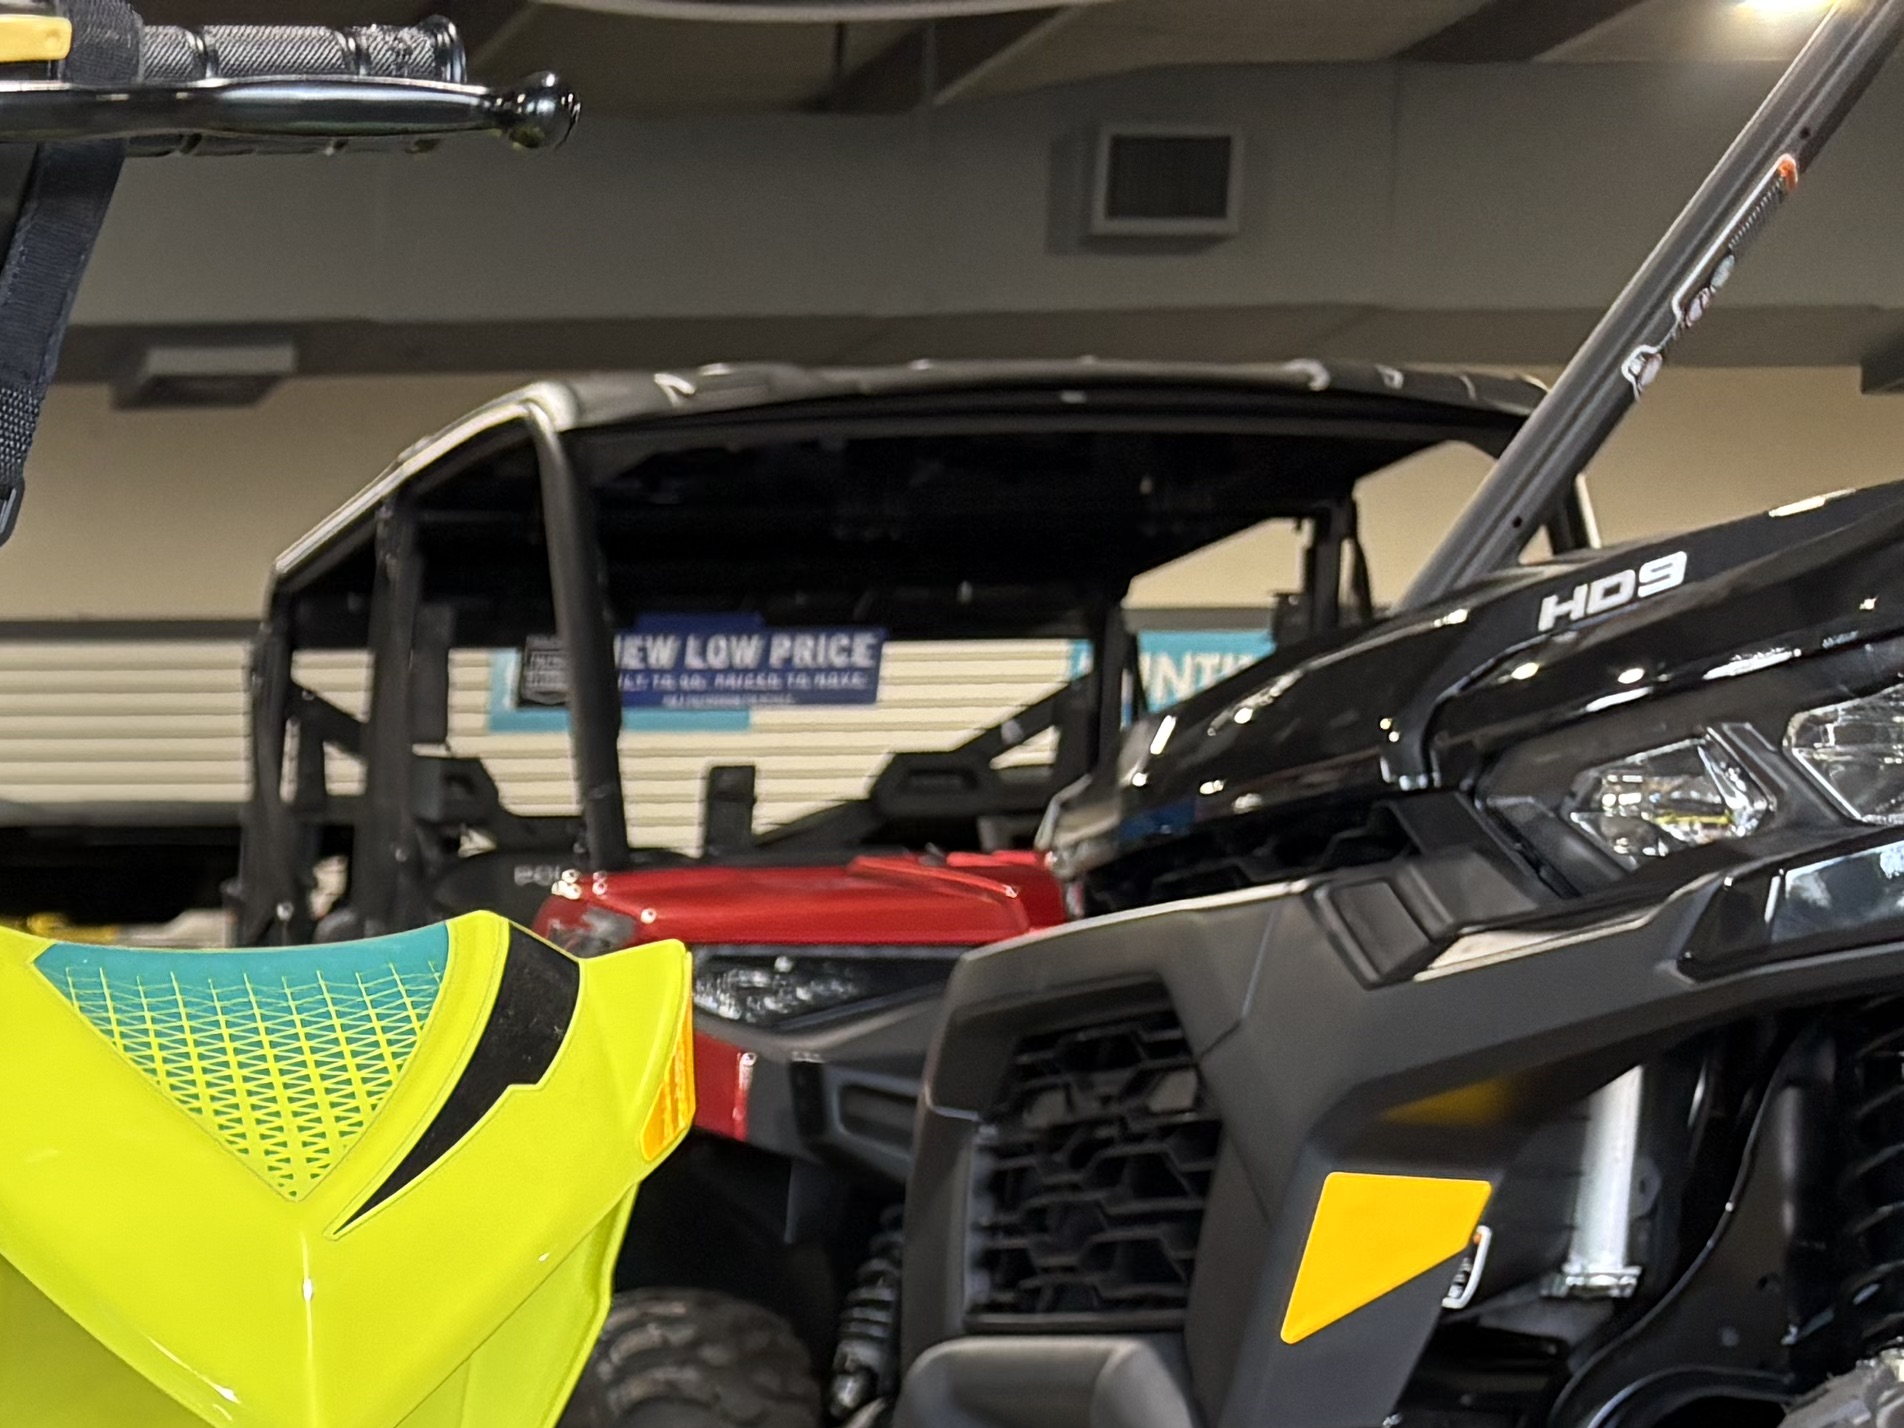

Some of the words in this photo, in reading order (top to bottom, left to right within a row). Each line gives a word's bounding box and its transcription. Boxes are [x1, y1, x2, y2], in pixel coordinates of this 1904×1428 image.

[1538, 551, 1688, 632] HD9
[612, 632, 681, 671] EW
[684, 632, 763, 671] LOW
[768, 632, 881, 671] PRICE
